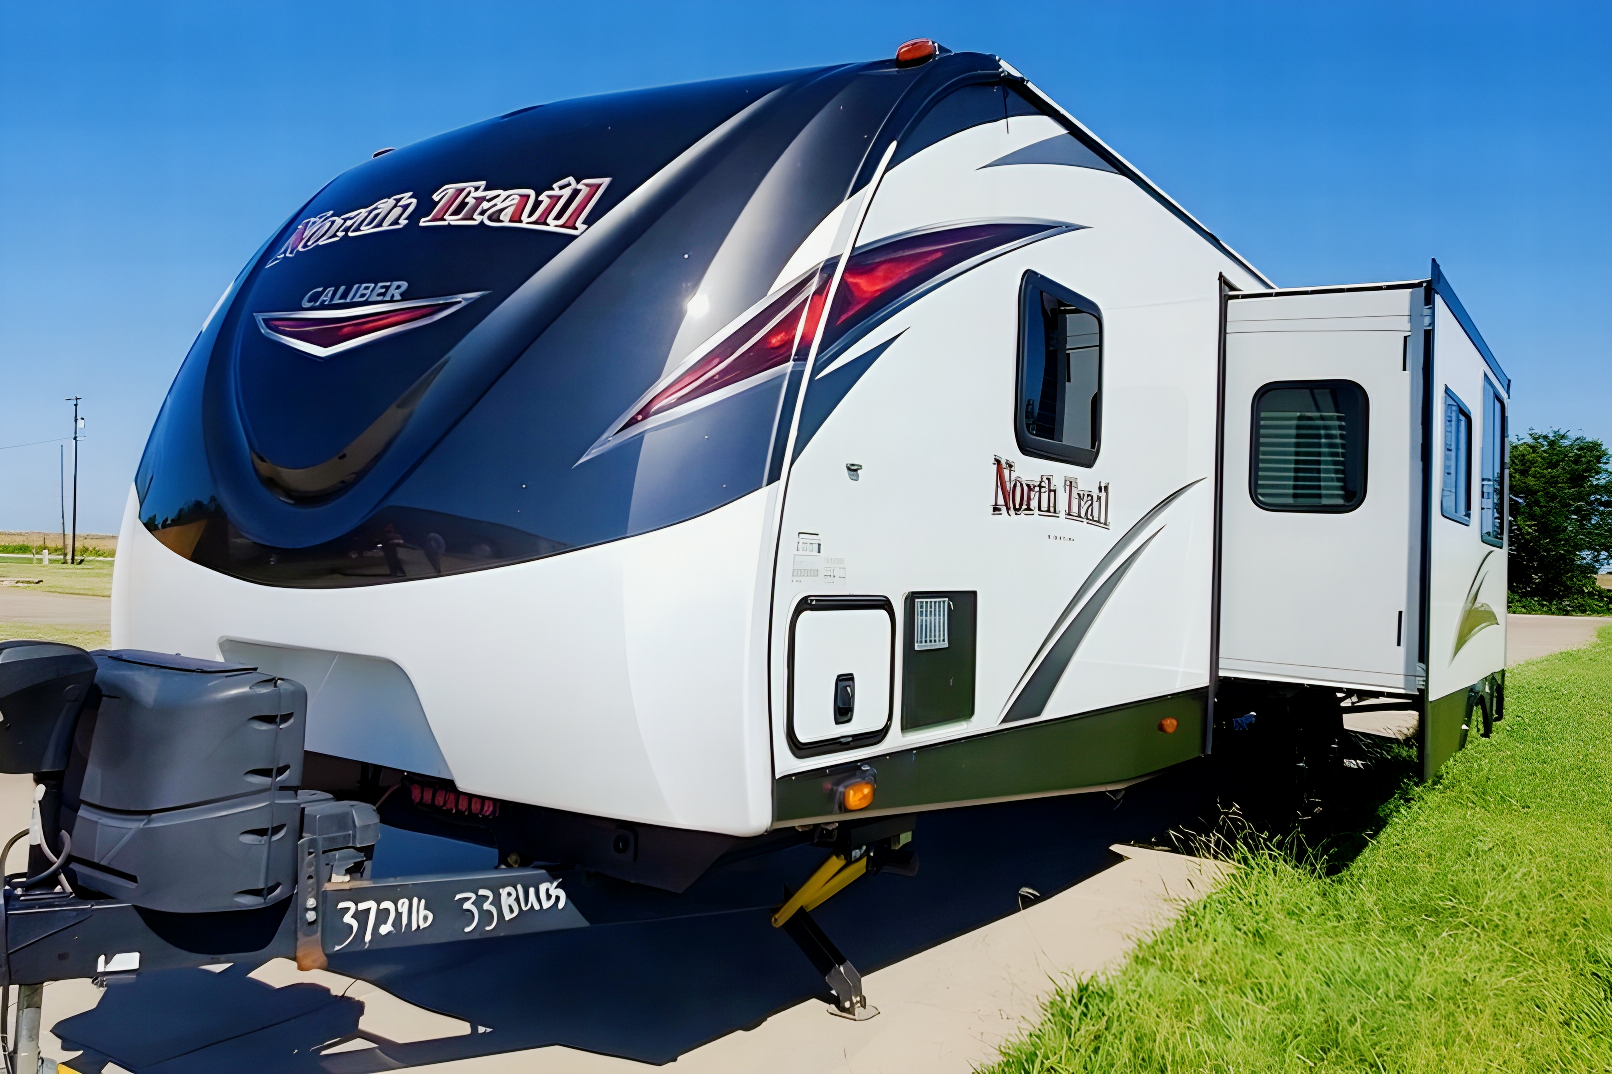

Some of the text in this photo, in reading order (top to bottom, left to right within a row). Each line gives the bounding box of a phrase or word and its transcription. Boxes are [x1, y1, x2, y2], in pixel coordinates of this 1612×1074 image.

[265, 176, 612, 268] North Trail
[301, 281, 408, 308] CALIBER
[990, 454, 1110, 530] North Trail
[334, 896, 433, 951] 372916
